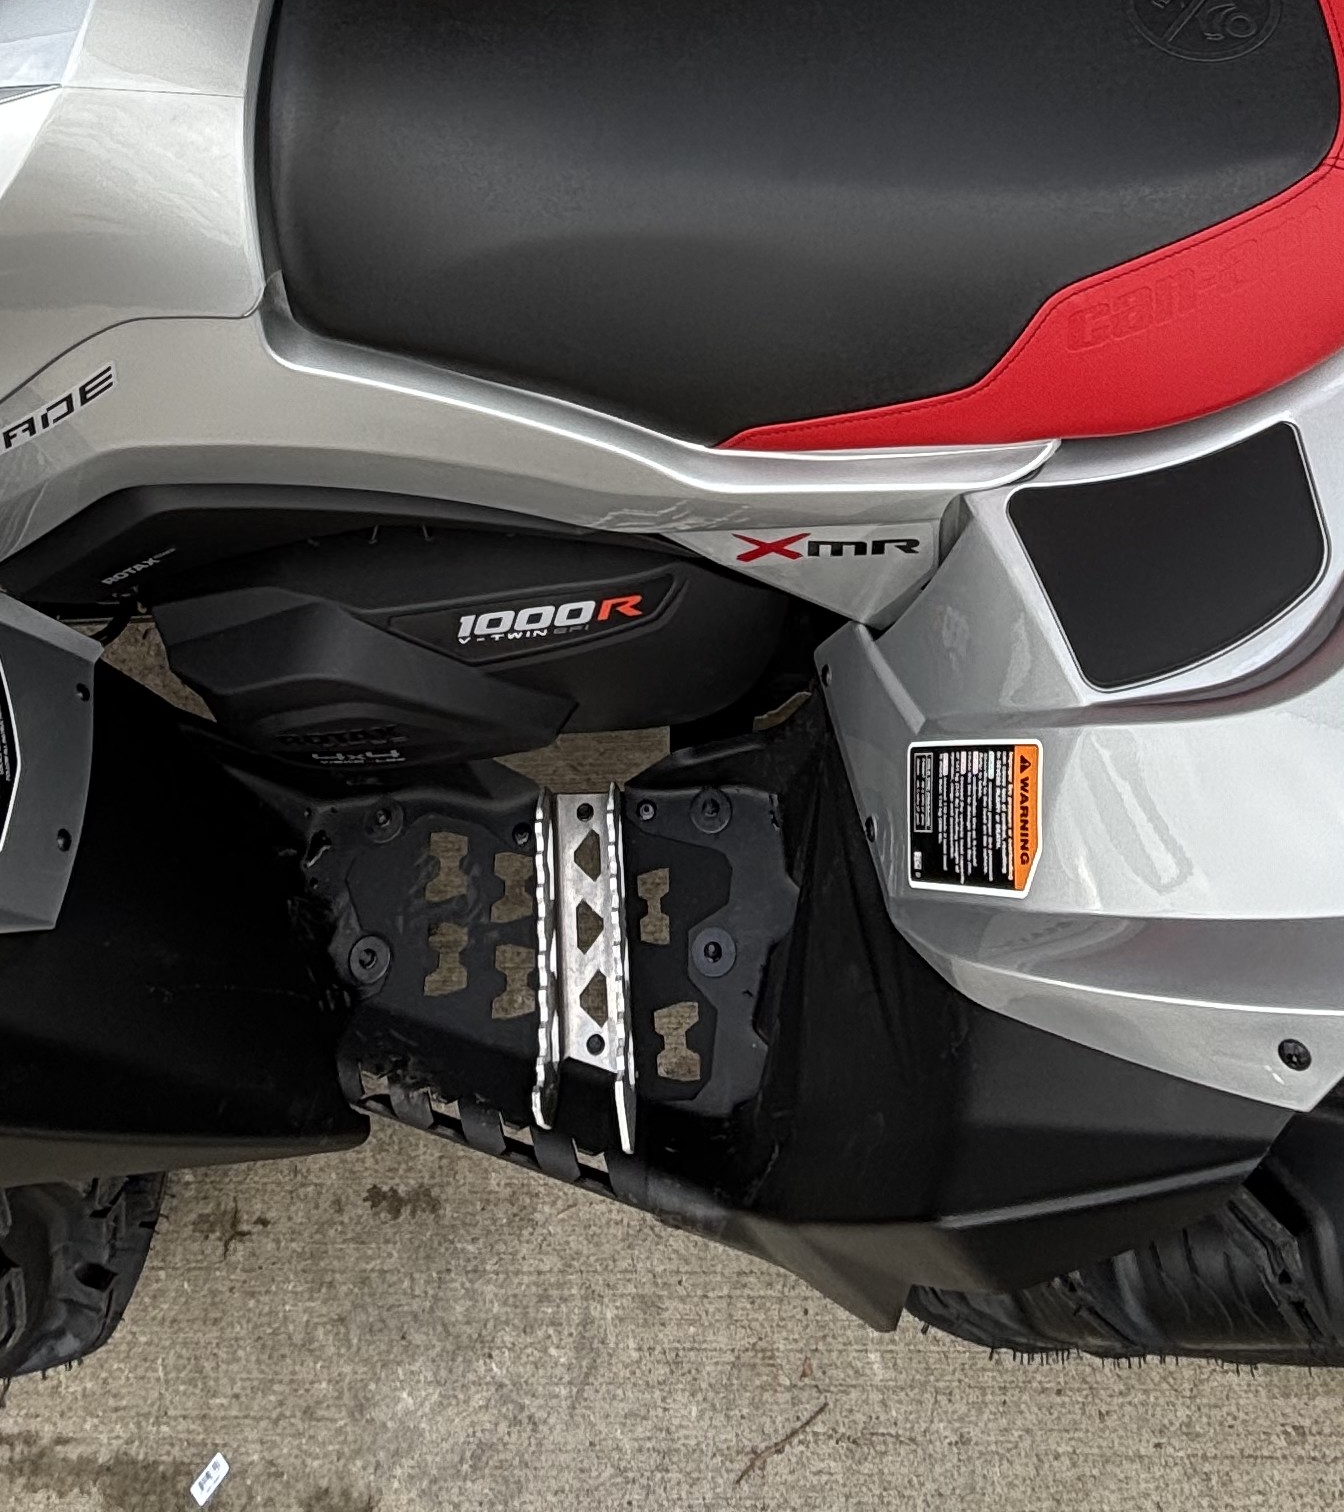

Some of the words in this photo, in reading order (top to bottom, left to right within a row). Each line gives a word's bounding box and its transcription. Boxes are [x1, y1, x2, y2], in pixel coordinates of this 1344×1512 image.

[101, 557, 161, 585] ROTAX
[456, 595, 644, 638] 1000R
[552, 624, 590, 635] EFI
[1020, 776, 1030, 865] WARNING
